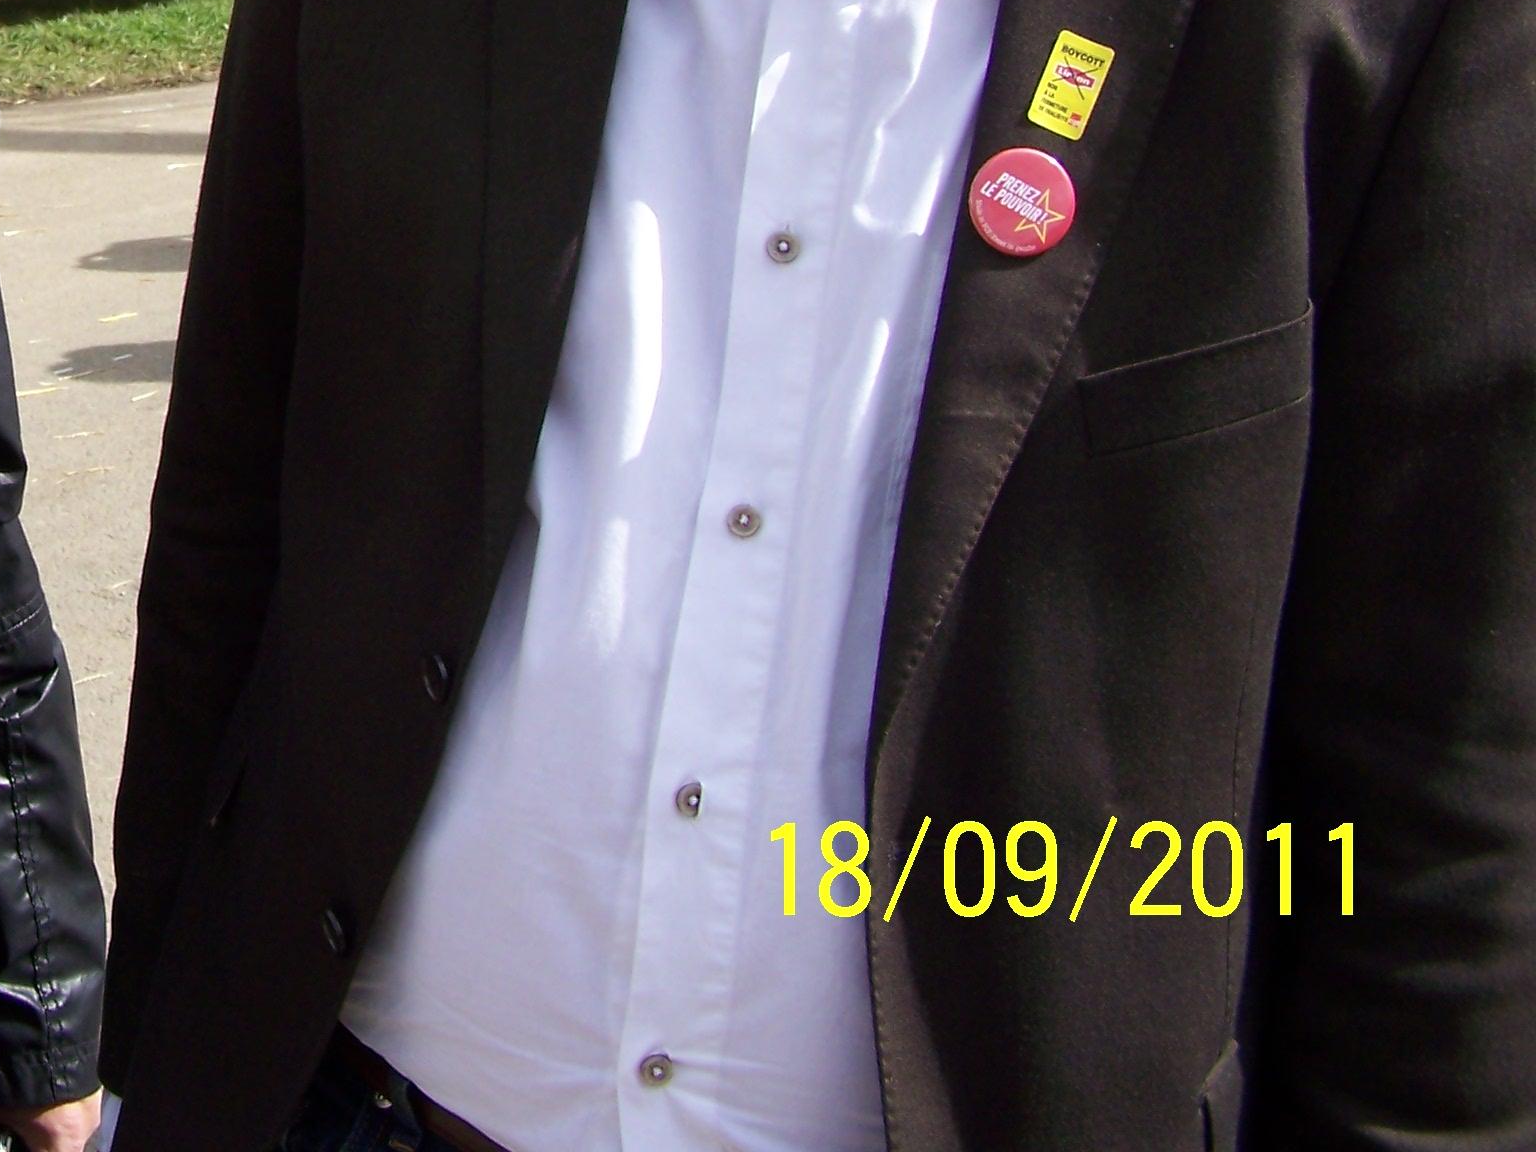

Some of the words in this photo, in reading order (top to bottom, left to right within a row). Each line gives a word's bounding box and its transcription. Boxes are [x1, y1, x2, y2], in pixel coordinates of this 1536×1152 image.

[1061, 44, 1106, 68] BOYCOTT
[980, 180, 998, 198] LE
[995, 172, 1042, 204] PRENEZ
